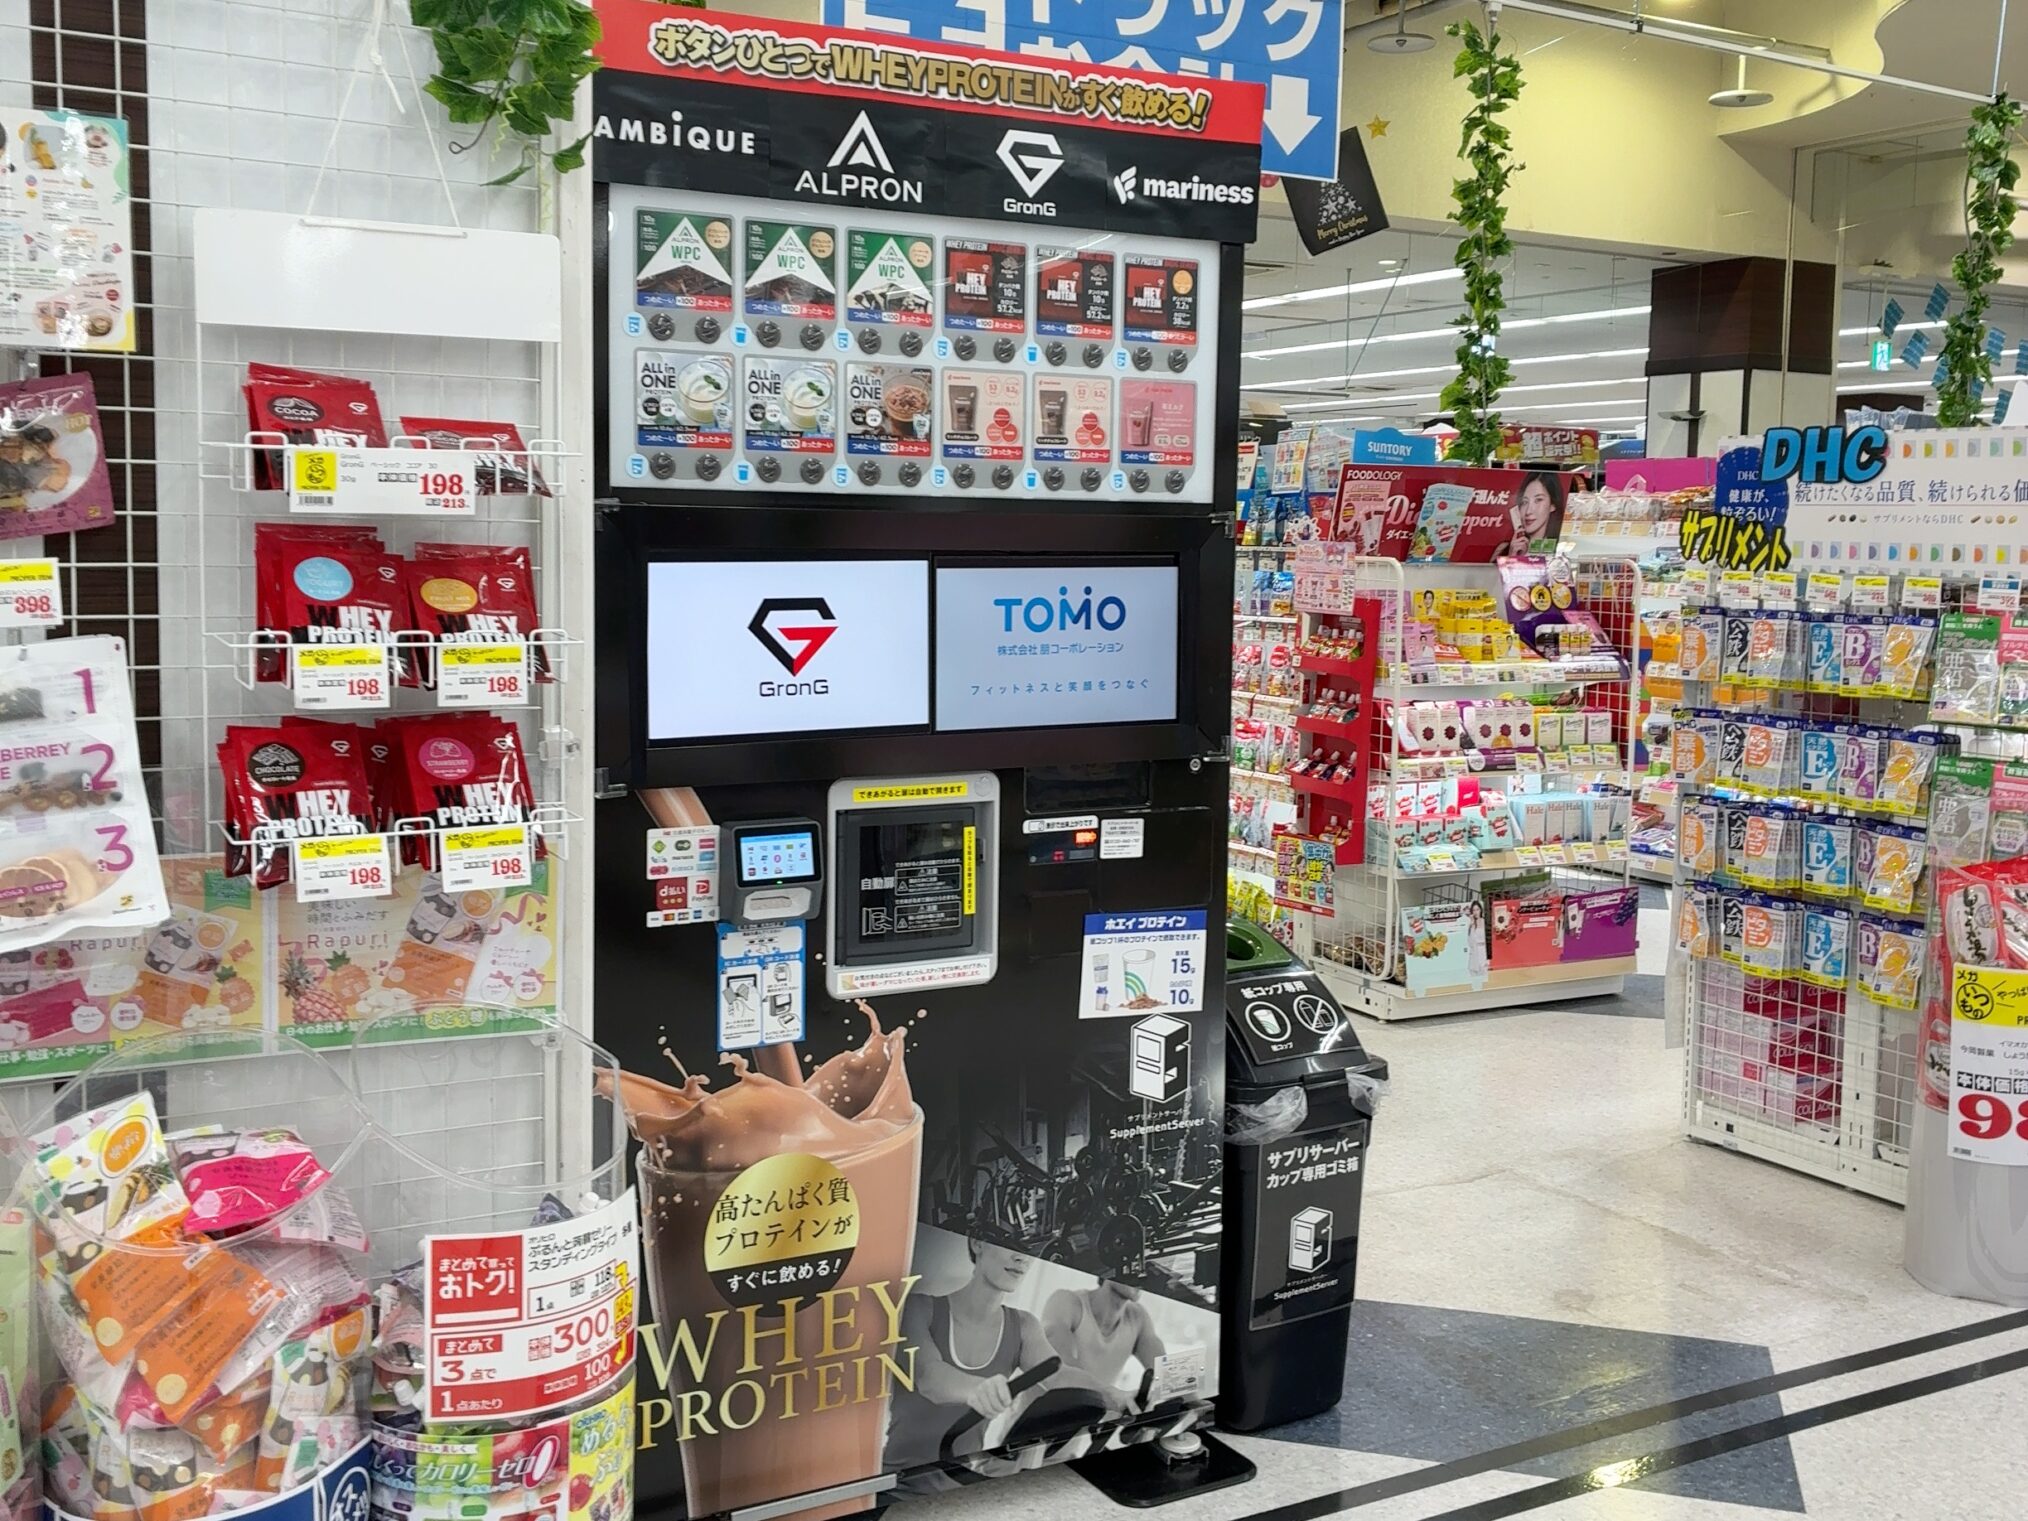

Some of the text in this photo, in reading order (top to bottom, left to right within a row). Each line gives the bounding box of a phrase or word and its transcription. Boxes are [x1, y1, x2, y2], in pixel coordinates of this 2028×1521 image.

[794, 170, 923, 203] ALPRON
[1143, 174, 1254, 205] mariness
[1003, 198, 1057, 217] GronG
[671, 245, 701, 260] WPC
[777, 254, 806, 270] WPC
[878, 263, 905, 279] WPC
[955, 283, 987, 295] PROTEIN
[1046, 290, 1077, 301] PROTEIN
[1132, 297, 1162, 308] PROTEIN
[641, 363, 676, 374] ALL in
[748, 369, 781, 380] ALL in
[641, 374, 677, 389] ONE
[748, 380, 781, 395] ONE
[850, 374, 881, 386] ALL in
[850, 385, 882, 400] ONE
[273, 406, 318, 418] COCOA
[1368, 441, 1413, 457] SUNTORY
[1761, 426, 1889, 484] DHC
[419, 473, 464, 495] 198
[1346, 470, 1402, 480] FOODOLOGY
[1737, 470, 1760, 481] DHC
[442, 498, 466, 509] 213
[1873, 514, 1964, 525] サプリメントならDHC
[1680, 509, 1792, 572] サプリメント
[15, 595, 51, 614] 398
[993, 586, 1126, 633] TOMO
[307, 604, 393, 630] WHEY
[437, 613, 518, 635] WHEY
[997, 644, 1038, 656] 株式会社
[1811, 641, 1828, 667] E
[1844, 633, 1866, 659] B
[74, 668, 97, 715] 1
[347, 678, 379, 696] 198
[487, 676, 518, 693] 198
[759, 679, 829, 698] GronG
[80, 743, 118, 791] 2
[255, 765, 300, 775] CHOCOLATE
[264, 789, 350, 818] WHEY
[431, 782, 512, 808] WHEY
[1526, 805, 1544, 815] Hale
[96, 824, 135, 873] 3
[1809, 842, 1828, 869] E
[350, 866, 381, 885] 198
[491, 857, 522, 876] 198
[1105, 916, 1187, 930] ホエイ プロテイン
[307, 930, 389, 949] Rapuri
[1807, 931, 1825, 958] E
[1957, 970, 1978, 982] メガ
[1110, 1117, 1205, 1140] SupplementServer
[1267, 1138, 1360, 1169] サプリサーバー
[1267, 1157, 1359, 1189] カップ専用ゴミ箱
[716, 1177, 851, 1224] 高たんぱく質
[716, 1214, 854, 1255] プロテインが
[439, 1256, 515, 1272] まとめて買って
[439, 1270, 515, 1300] おトク!
[728, 1258, 842, 1293] すぐに飲める!
[554, 1308, 609, 1354] 300
[637, 1274, 923, 1391] WHEY
[445, 1337, 496, 1354] まとめて
[441, 1359, 496, 1383] 3 点で
[584, 1353, 612, 1381] 100
[440, 1390, 503, 1412] 1 点あたり
[636, 1346, 921, 1450] PROTEIN
